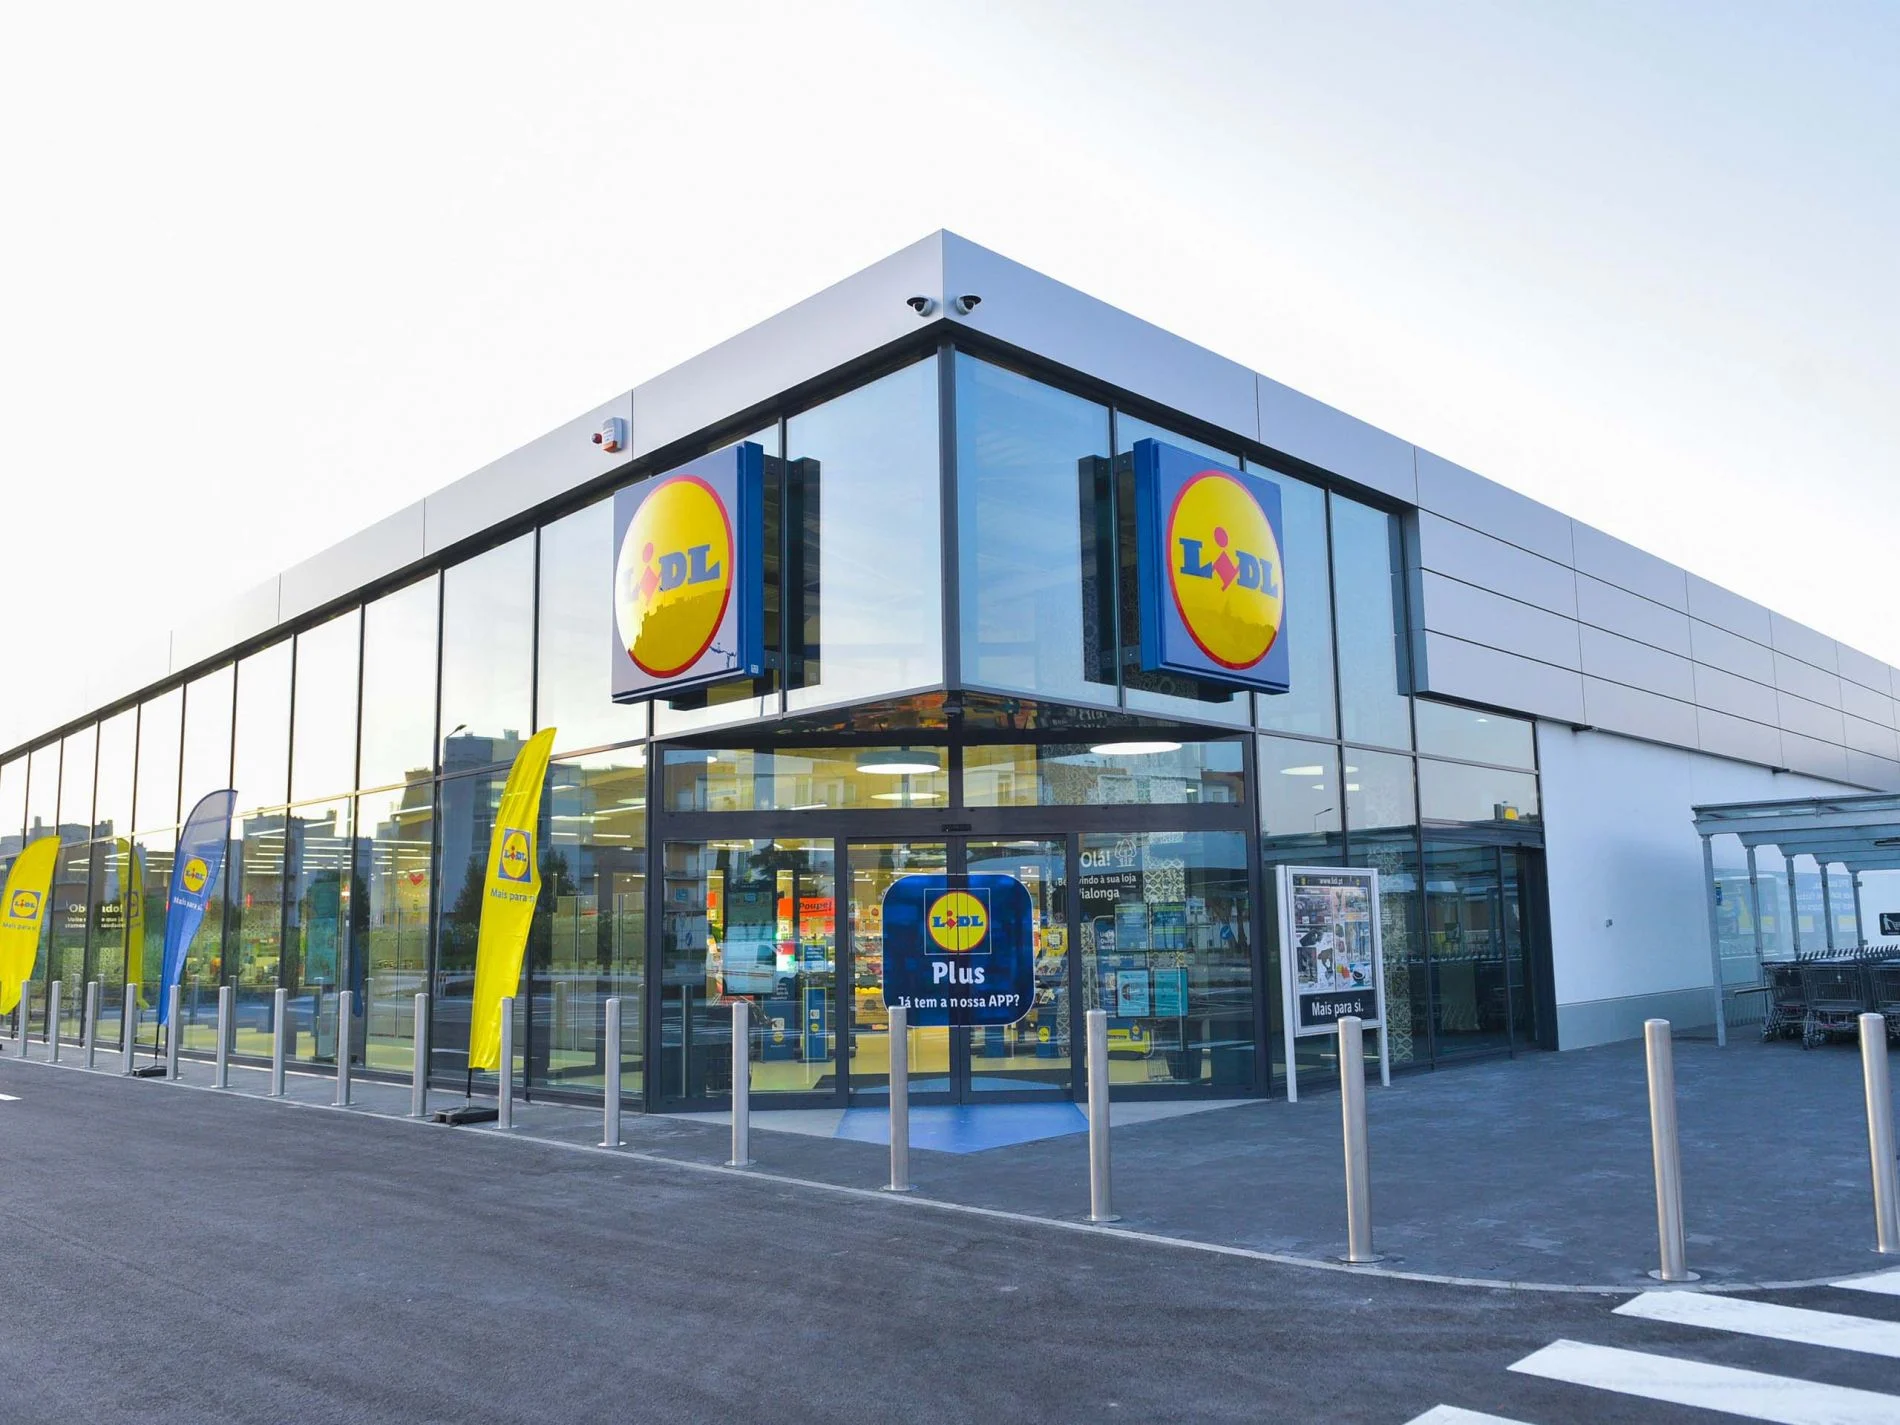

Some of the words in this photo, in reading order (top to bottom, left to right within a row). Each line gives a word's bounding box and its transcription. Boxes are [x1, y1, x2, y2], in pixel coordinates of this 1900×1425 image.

[1080, 850, 1111, 868] Olá!
[1121, 873, 1137, 886] loja
[1079, 886, 1120, 901] ialonga
[931, 960, 985, 985] Plus
[914, 996, 937, 1009] tem
[940, 998, 948, 1008] a
[950, 998, 986, 1008] nossa
[988, 993, 1020, 1008] APP?
[1310, 1001, 1333, 1017] Mais
[1333, 1002, 1353, 1018] para
[1354, 998, 1365, 1013] si.
